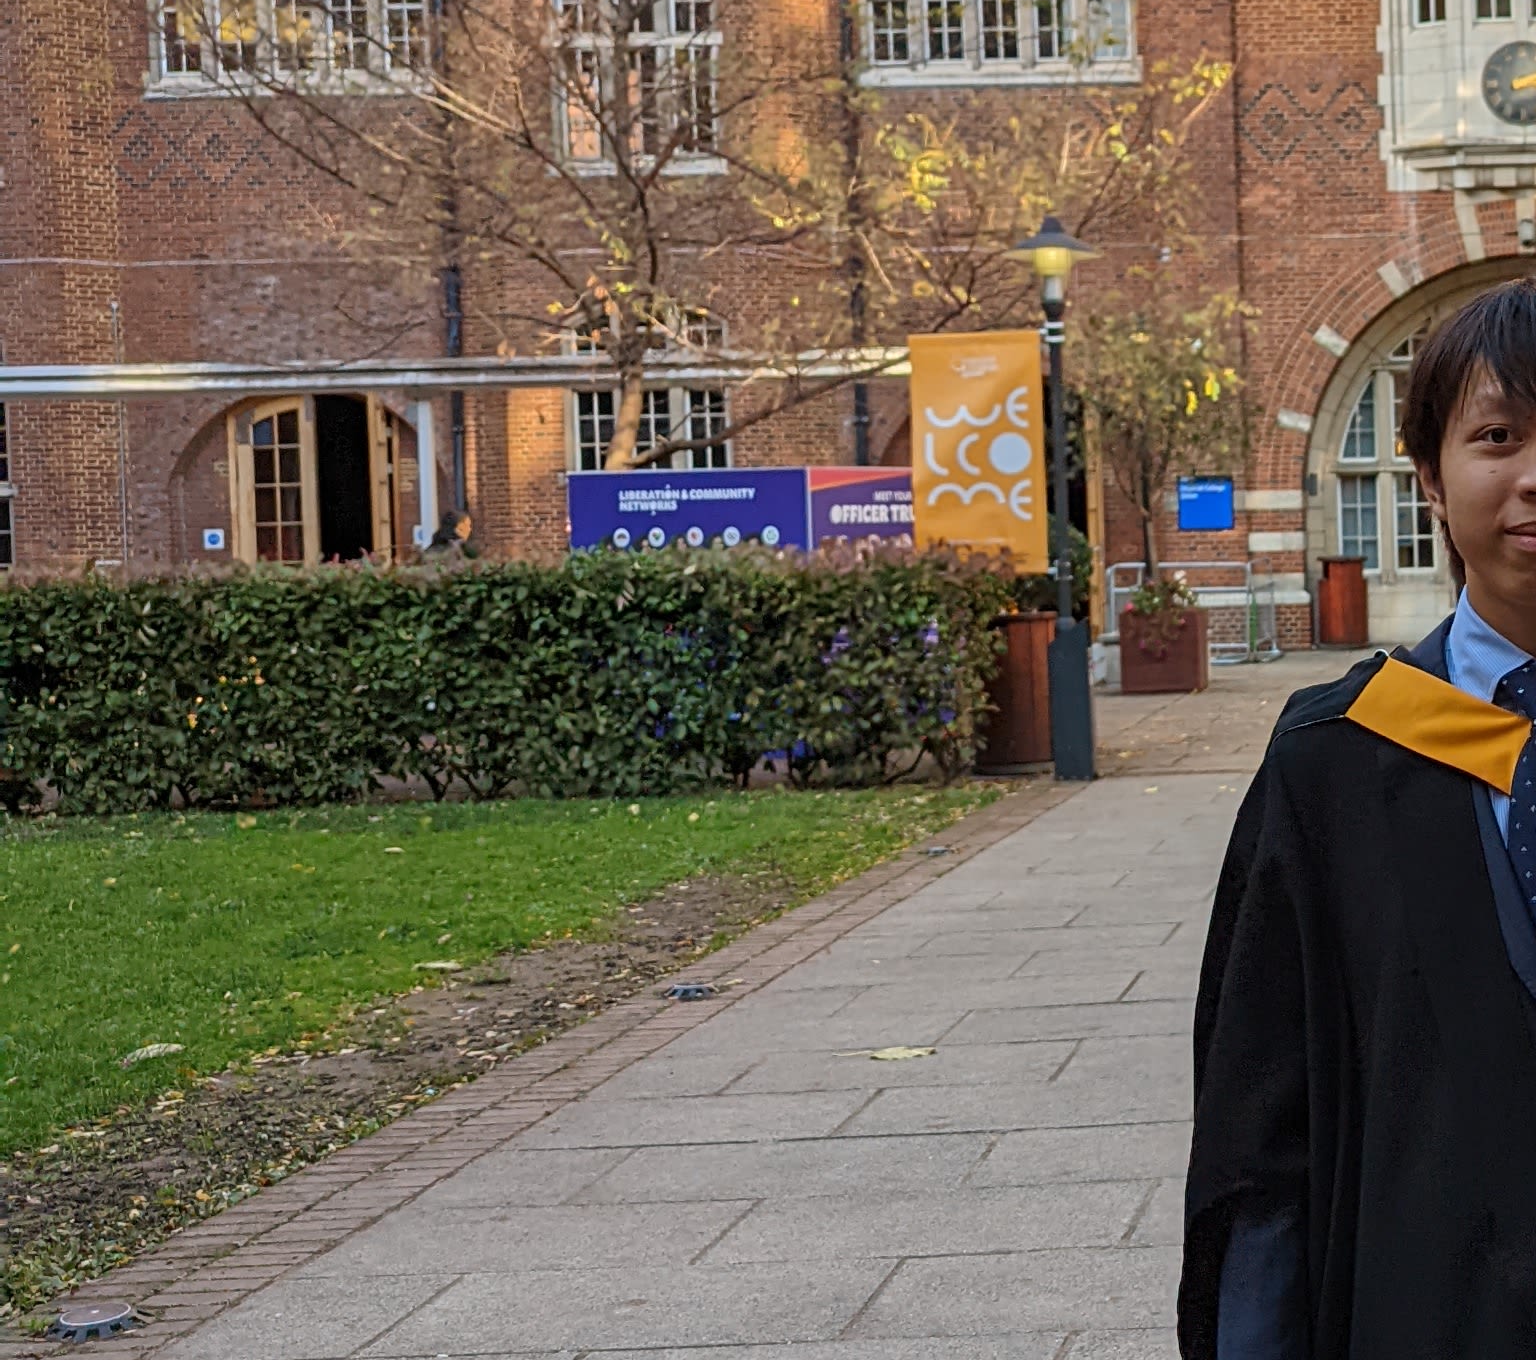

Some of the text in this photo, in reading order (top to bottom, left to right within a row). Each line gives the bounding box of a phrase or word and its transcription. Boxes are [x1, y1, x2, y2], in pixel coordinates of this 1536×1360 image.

[618, 489, 680, 501] LIBERATION
[690, 488, 755, 500] COMMUNITY
[618, 500, 678, 512] NETWORKS
[829, 504, 889, 524] OFFICER
